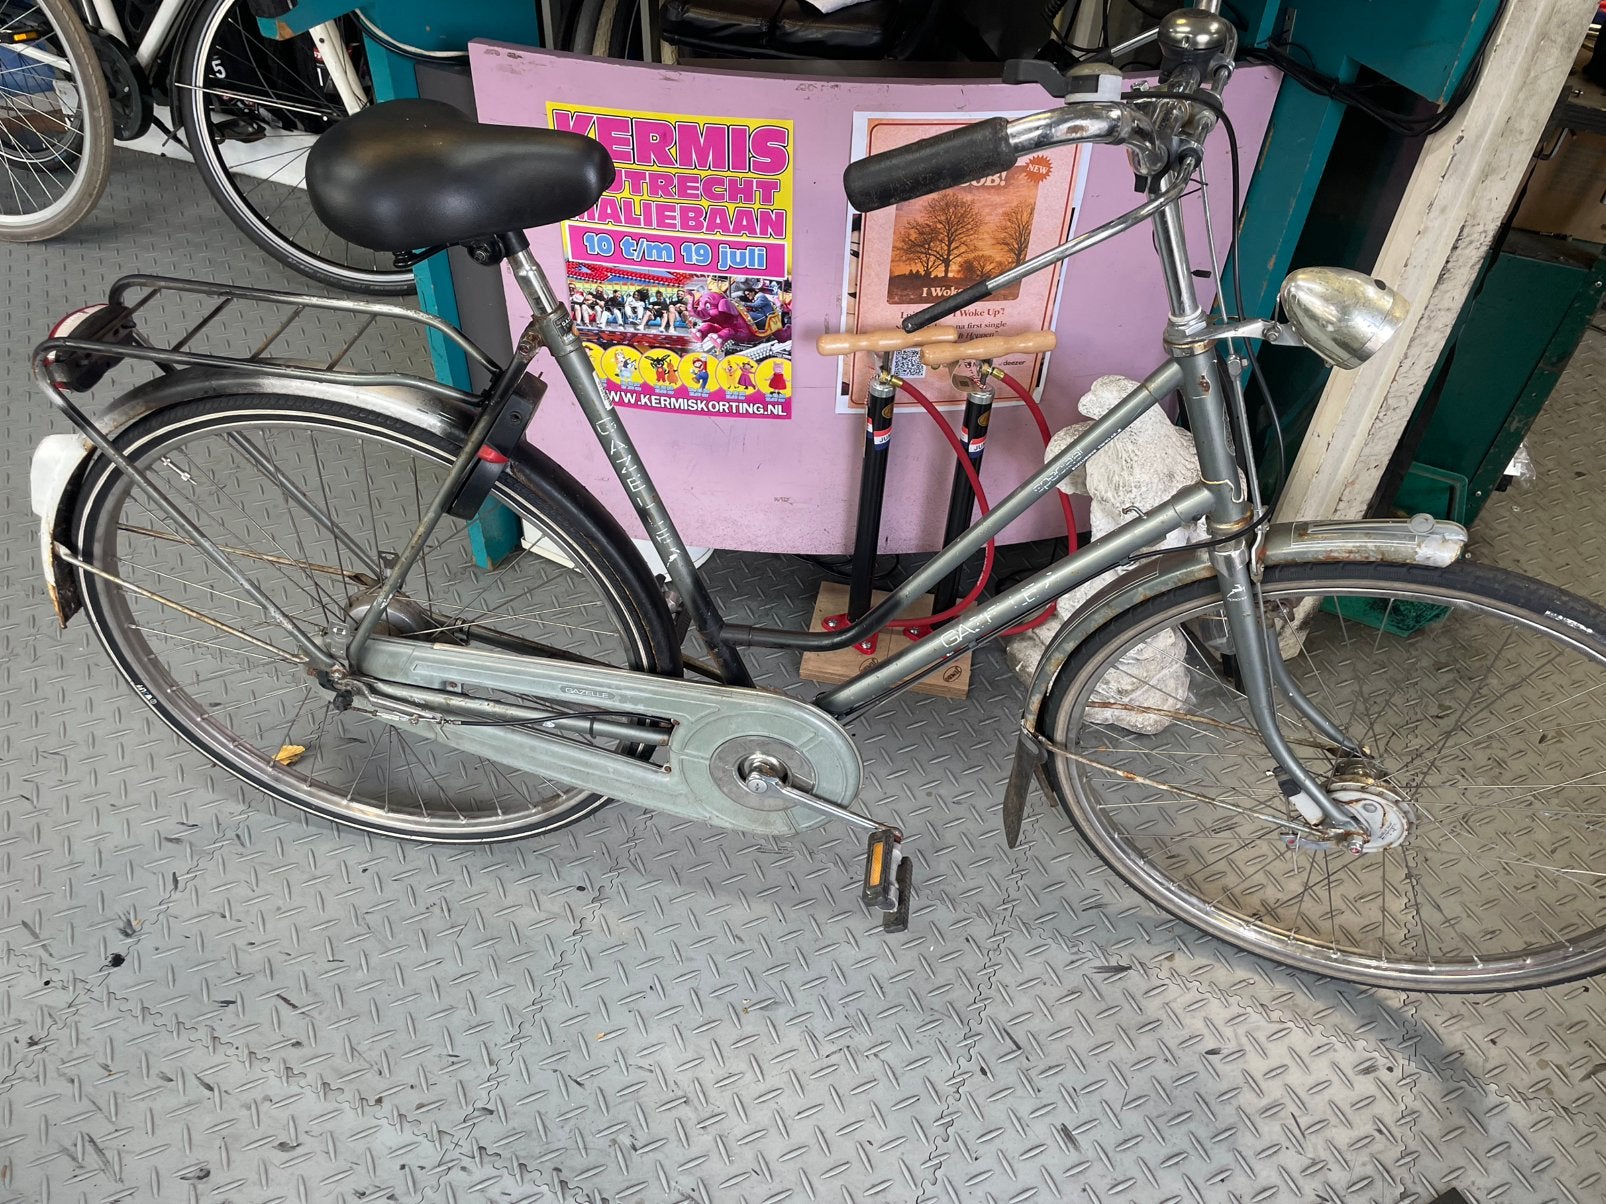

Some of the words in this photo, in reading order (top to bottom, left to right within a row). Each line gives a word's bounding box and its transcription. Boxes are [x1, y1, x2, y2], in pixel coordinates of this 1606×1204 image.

[211, 59, 227, 79] 5
[1027, 164, 1048, 175] NEW
[570, 195, 787, 239] ALIEBAAN
[583, 232, 615, 257] 10
[620, 235, 676, 263] t/m
[680, 242, 713, 266] 19
[717, 244, 768, 270] juli
[921, 287, 929, 297] I
[960, 308, 985, 317] Woke
[967, 322, 983, 330] first
[984, 320, 1008, 330] single
[605, 389, 787, 416] WW.KERMISKORTING.NL
[565, 686, 609, 699] GAZELLE
